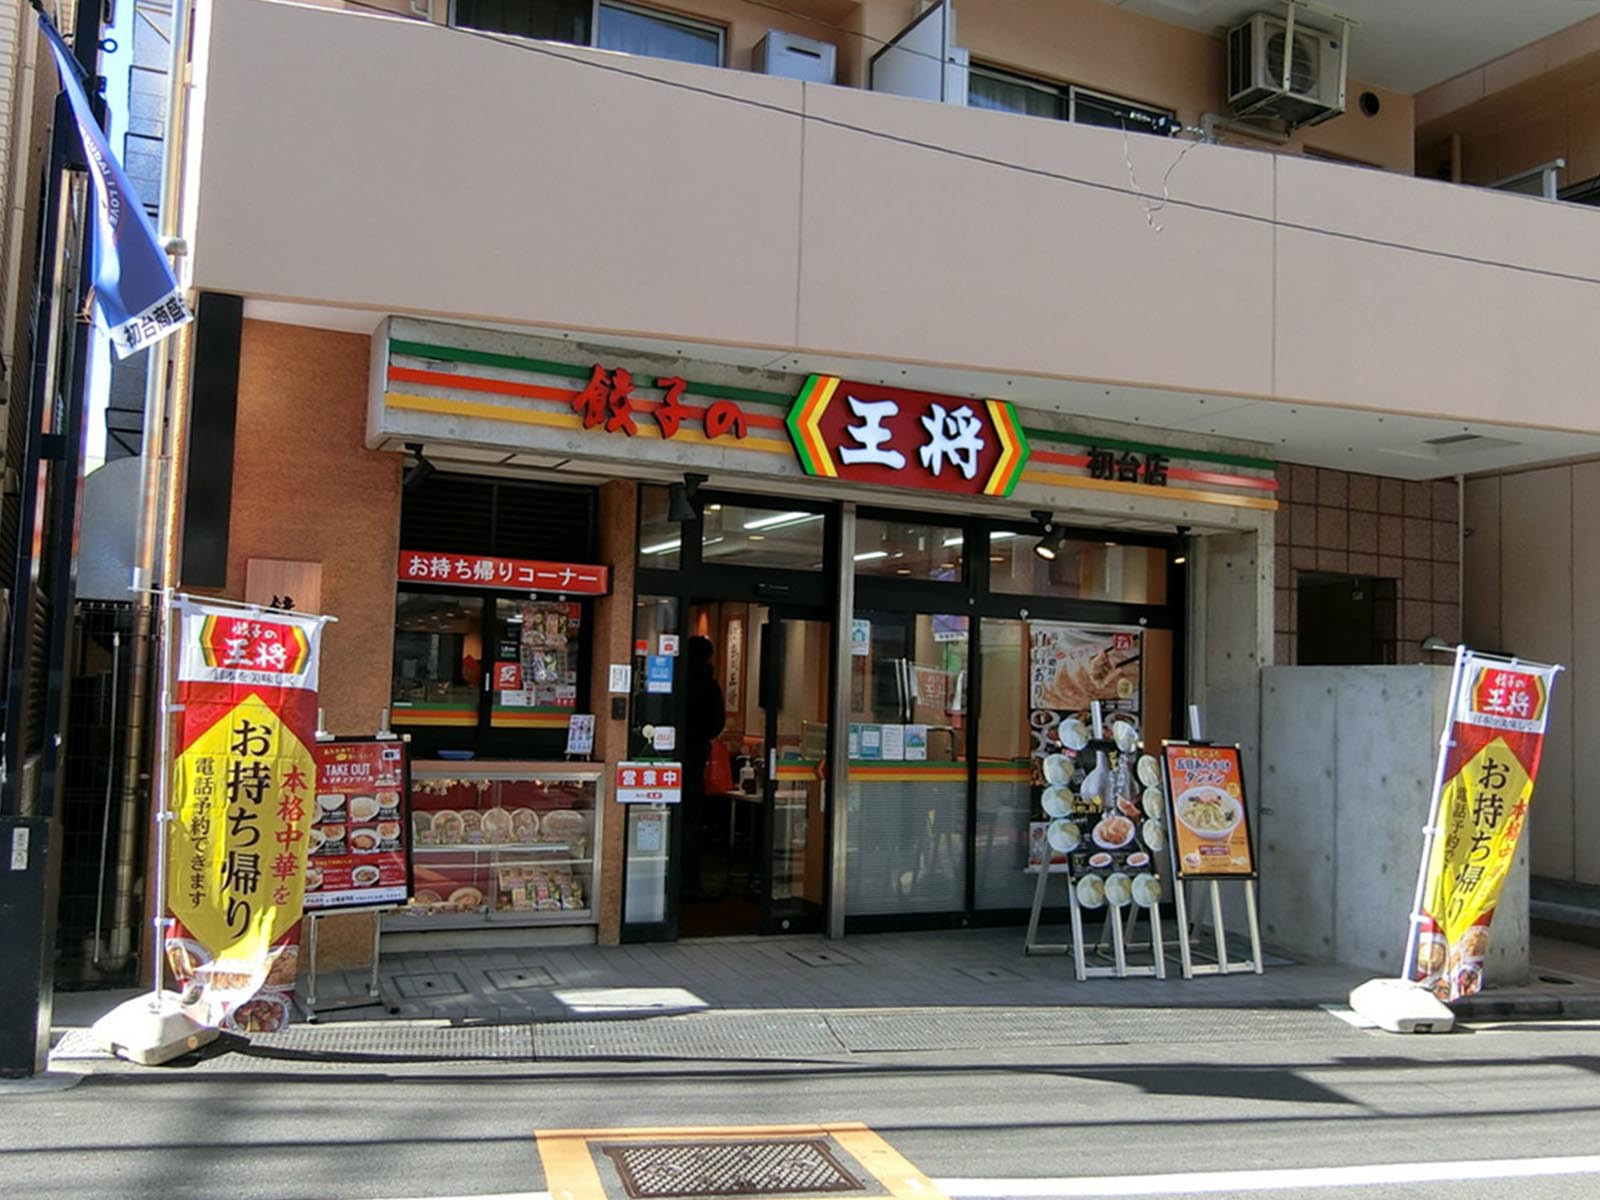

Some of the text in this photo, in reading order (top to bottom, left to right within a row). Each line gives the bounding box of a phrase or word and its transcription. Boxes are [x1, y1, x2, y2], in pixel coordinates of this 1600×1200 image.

[572, 362, 748, 440] 餃子の
[838, 394, 985, 481] 王将
[1086, 446, 1170, 486] 初台店
[408, 556, 598, 586] お持ち帰りコーナー
[232, 621, 278, 639] 餃子の
[223, 638, 288, 670] 王将
[1483, 689, 1530, 717] 王将
[325, 762, 371, 776] TAKE OUT
[622, 770, 677, 786] 営業中
[188, 756, 216, 909] 電話予約できます
[221, 718, 272, 940] お持ち帰り
[270, 763, 309, 907] 本格中華を
[1448, 757, 1510, 928] お持ち帰り
